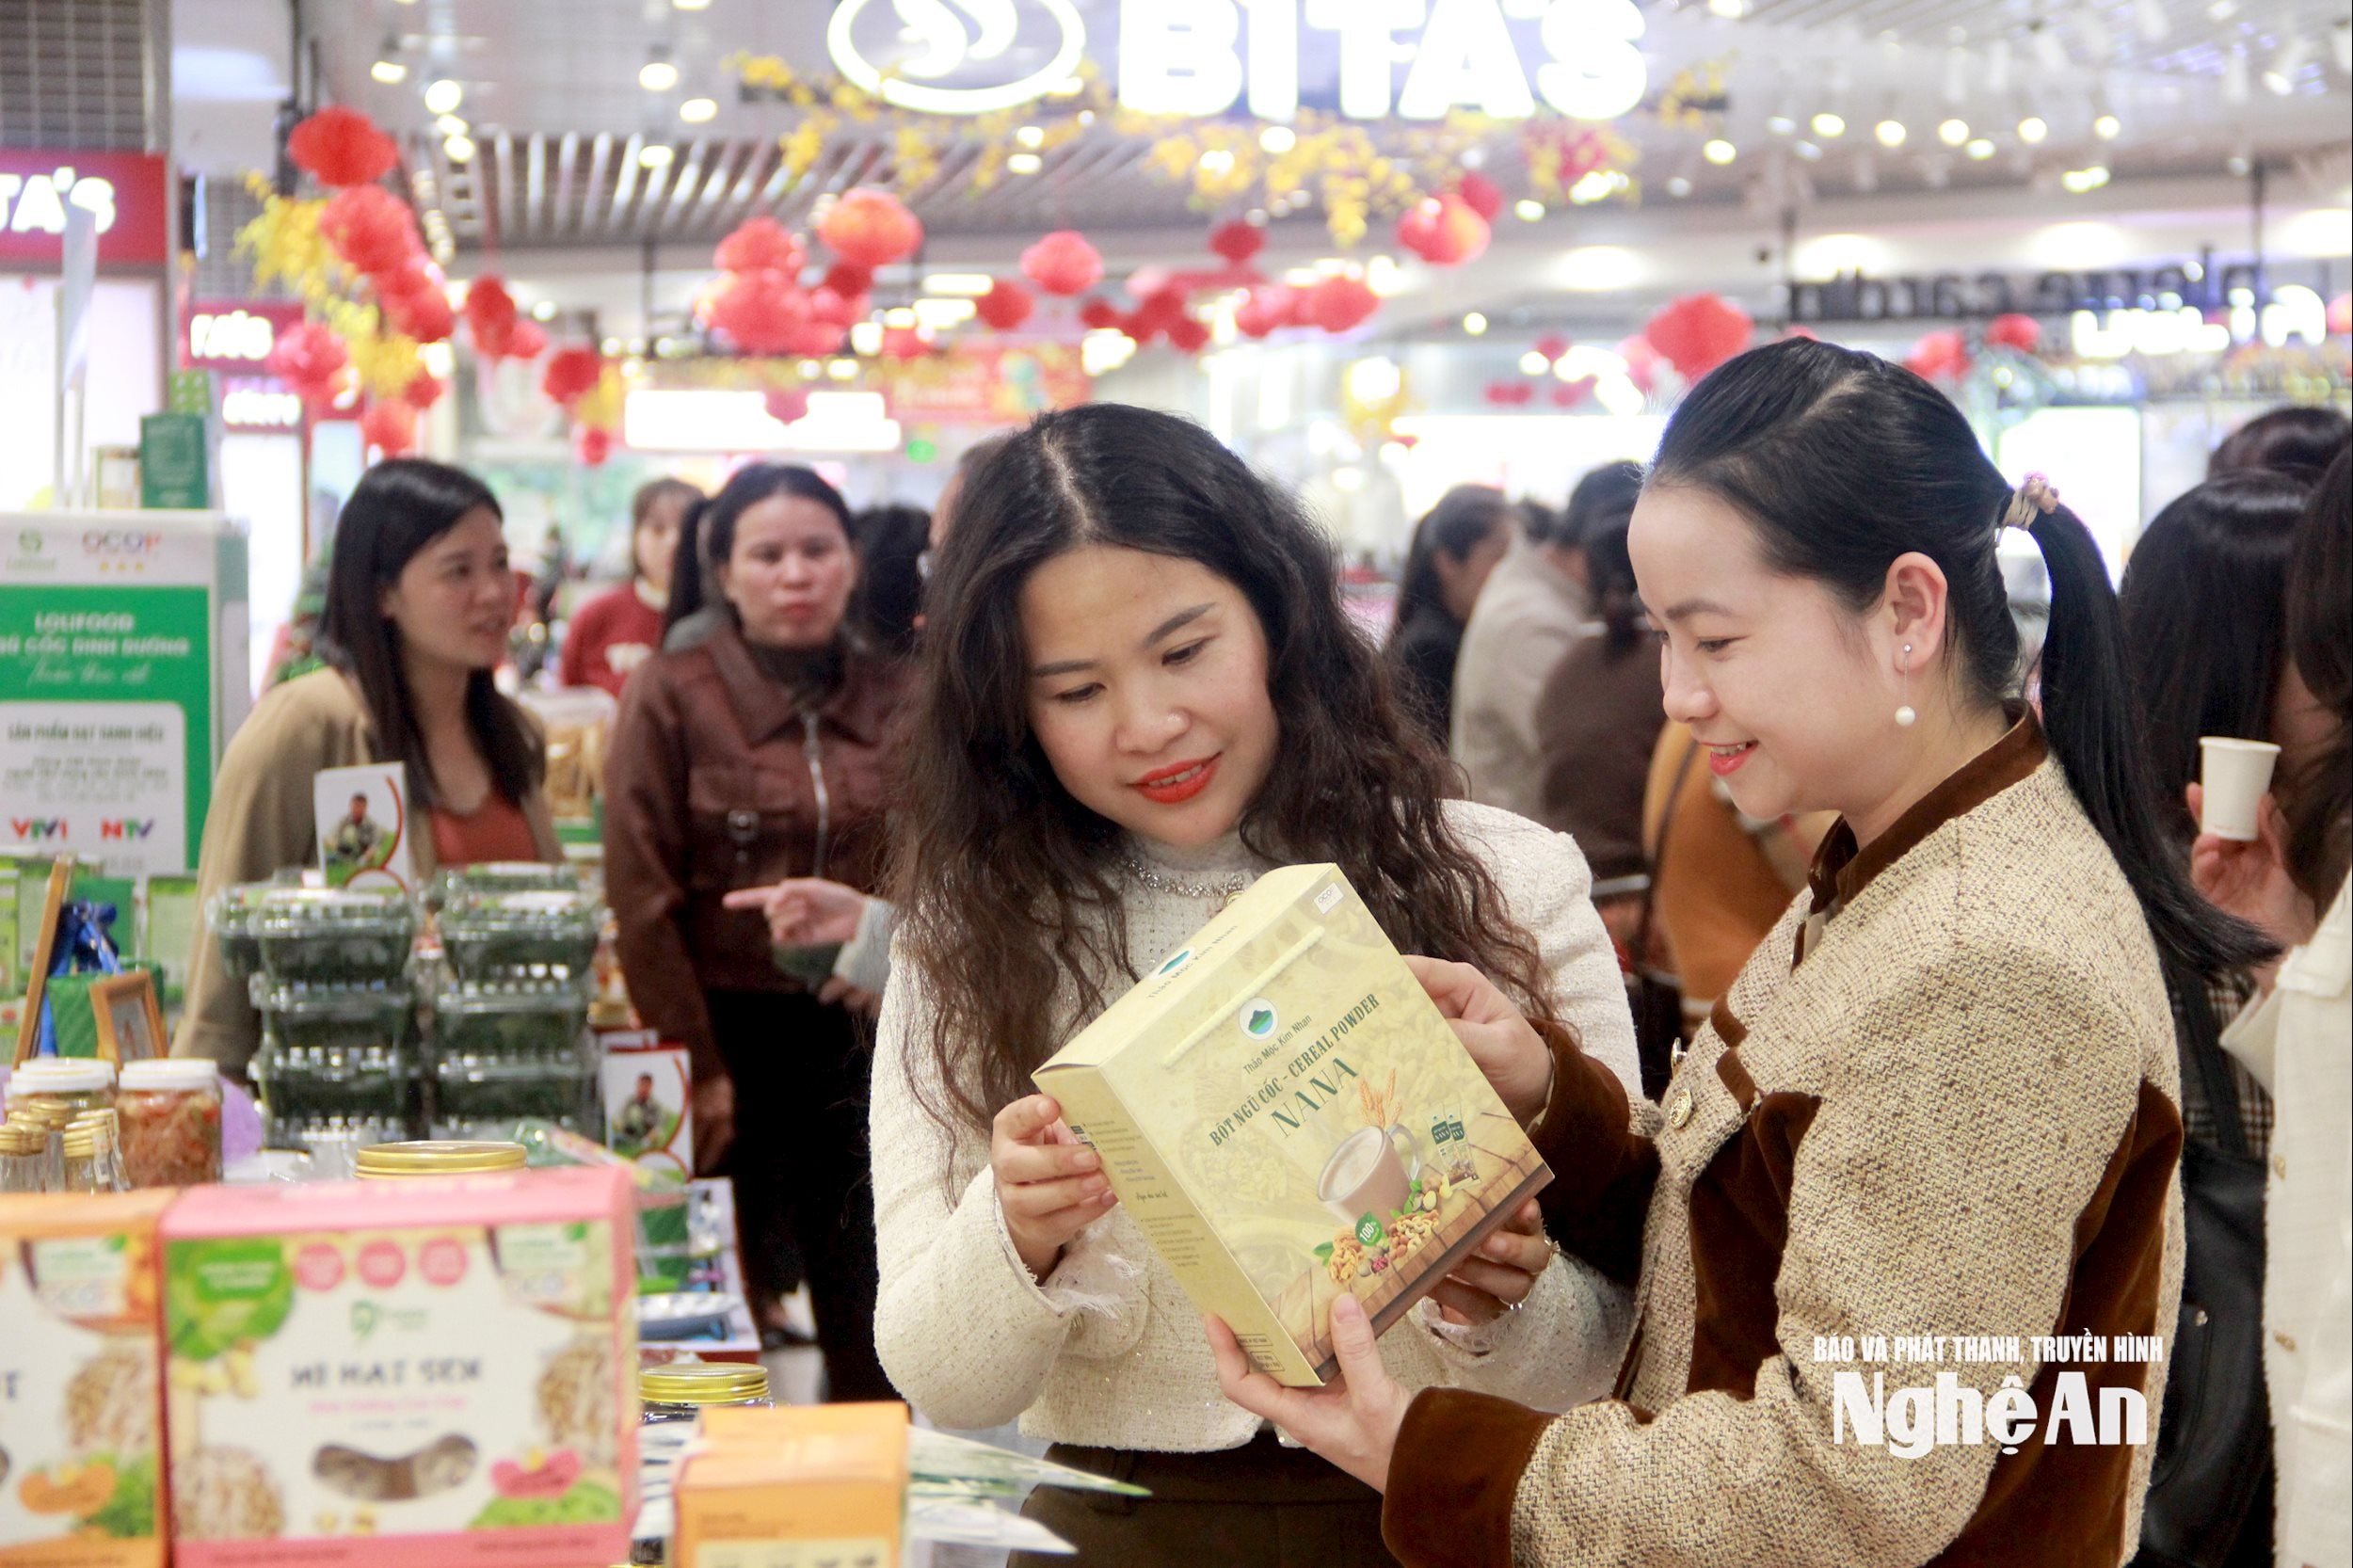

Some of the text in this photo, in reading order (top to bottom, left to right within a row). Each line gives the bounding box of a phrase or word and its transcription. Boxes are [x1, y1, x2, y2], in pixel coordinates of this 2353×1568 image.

[1209, 1118, 1232, 1146] BỘT
[1257, 1076, 1284, 1104] CỐC
[1288, 1034, 1334, 1079] CEREAL
[1329, 993, 1380, 1042] POWDER
[1277, 1032, 1294, 1046] Kim
[1271, 1057, 1358, 1138] NANA
